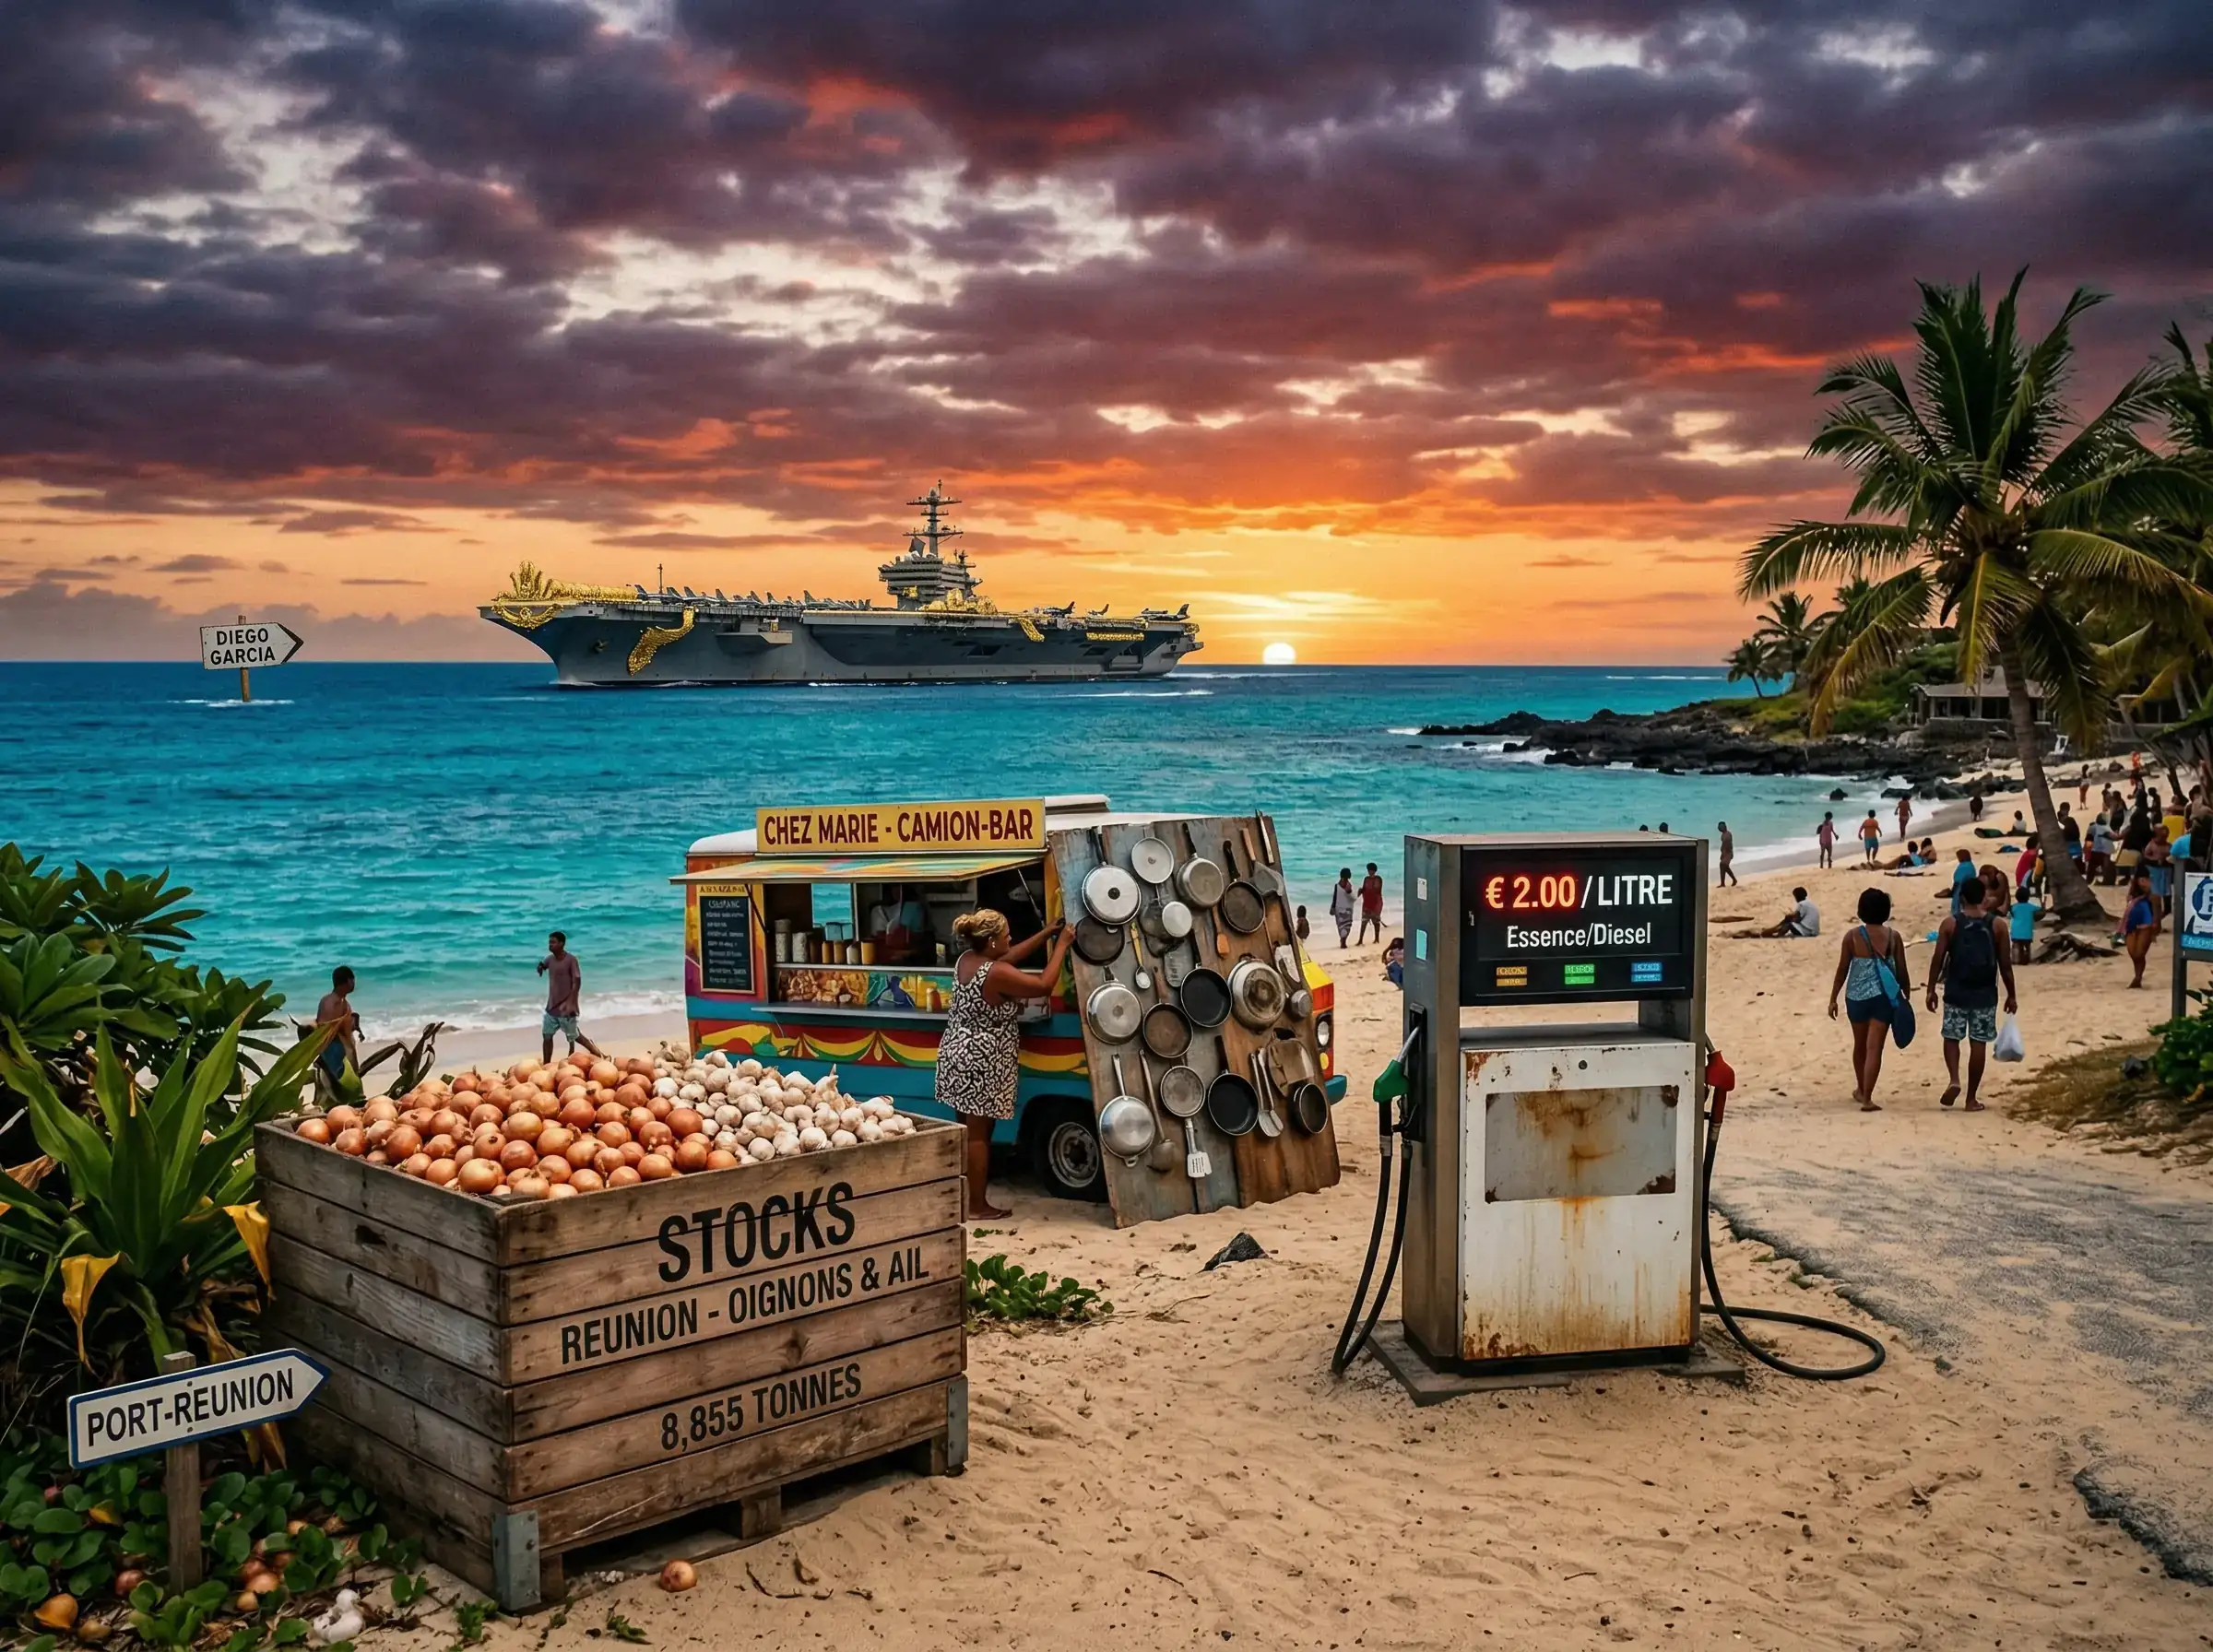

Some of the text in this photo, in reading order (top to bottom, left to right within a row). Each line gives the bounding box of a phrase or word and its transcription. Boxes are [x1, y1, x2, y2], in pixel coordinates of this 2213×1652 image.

[210, 646, 276, 665] GARCIA
[216, 628, 269, 645] DIEGO
[763, 815, 812, 844] CHEZ
[818, 813, 879, 844] MARIE
[897, 808, 1034, 843] CAMION-BAR
[1507, 922, 1651, 949] Essence/Diesel
[658, 1182, 855, 1282] STOCKS
[562, 1246, 929, 1364] REUNION - OIGNONS & AIL
[87, 1368, 294, 1447] PORT-REUNION
[661, 1363, 861, 1452] 8,855 TONNES
